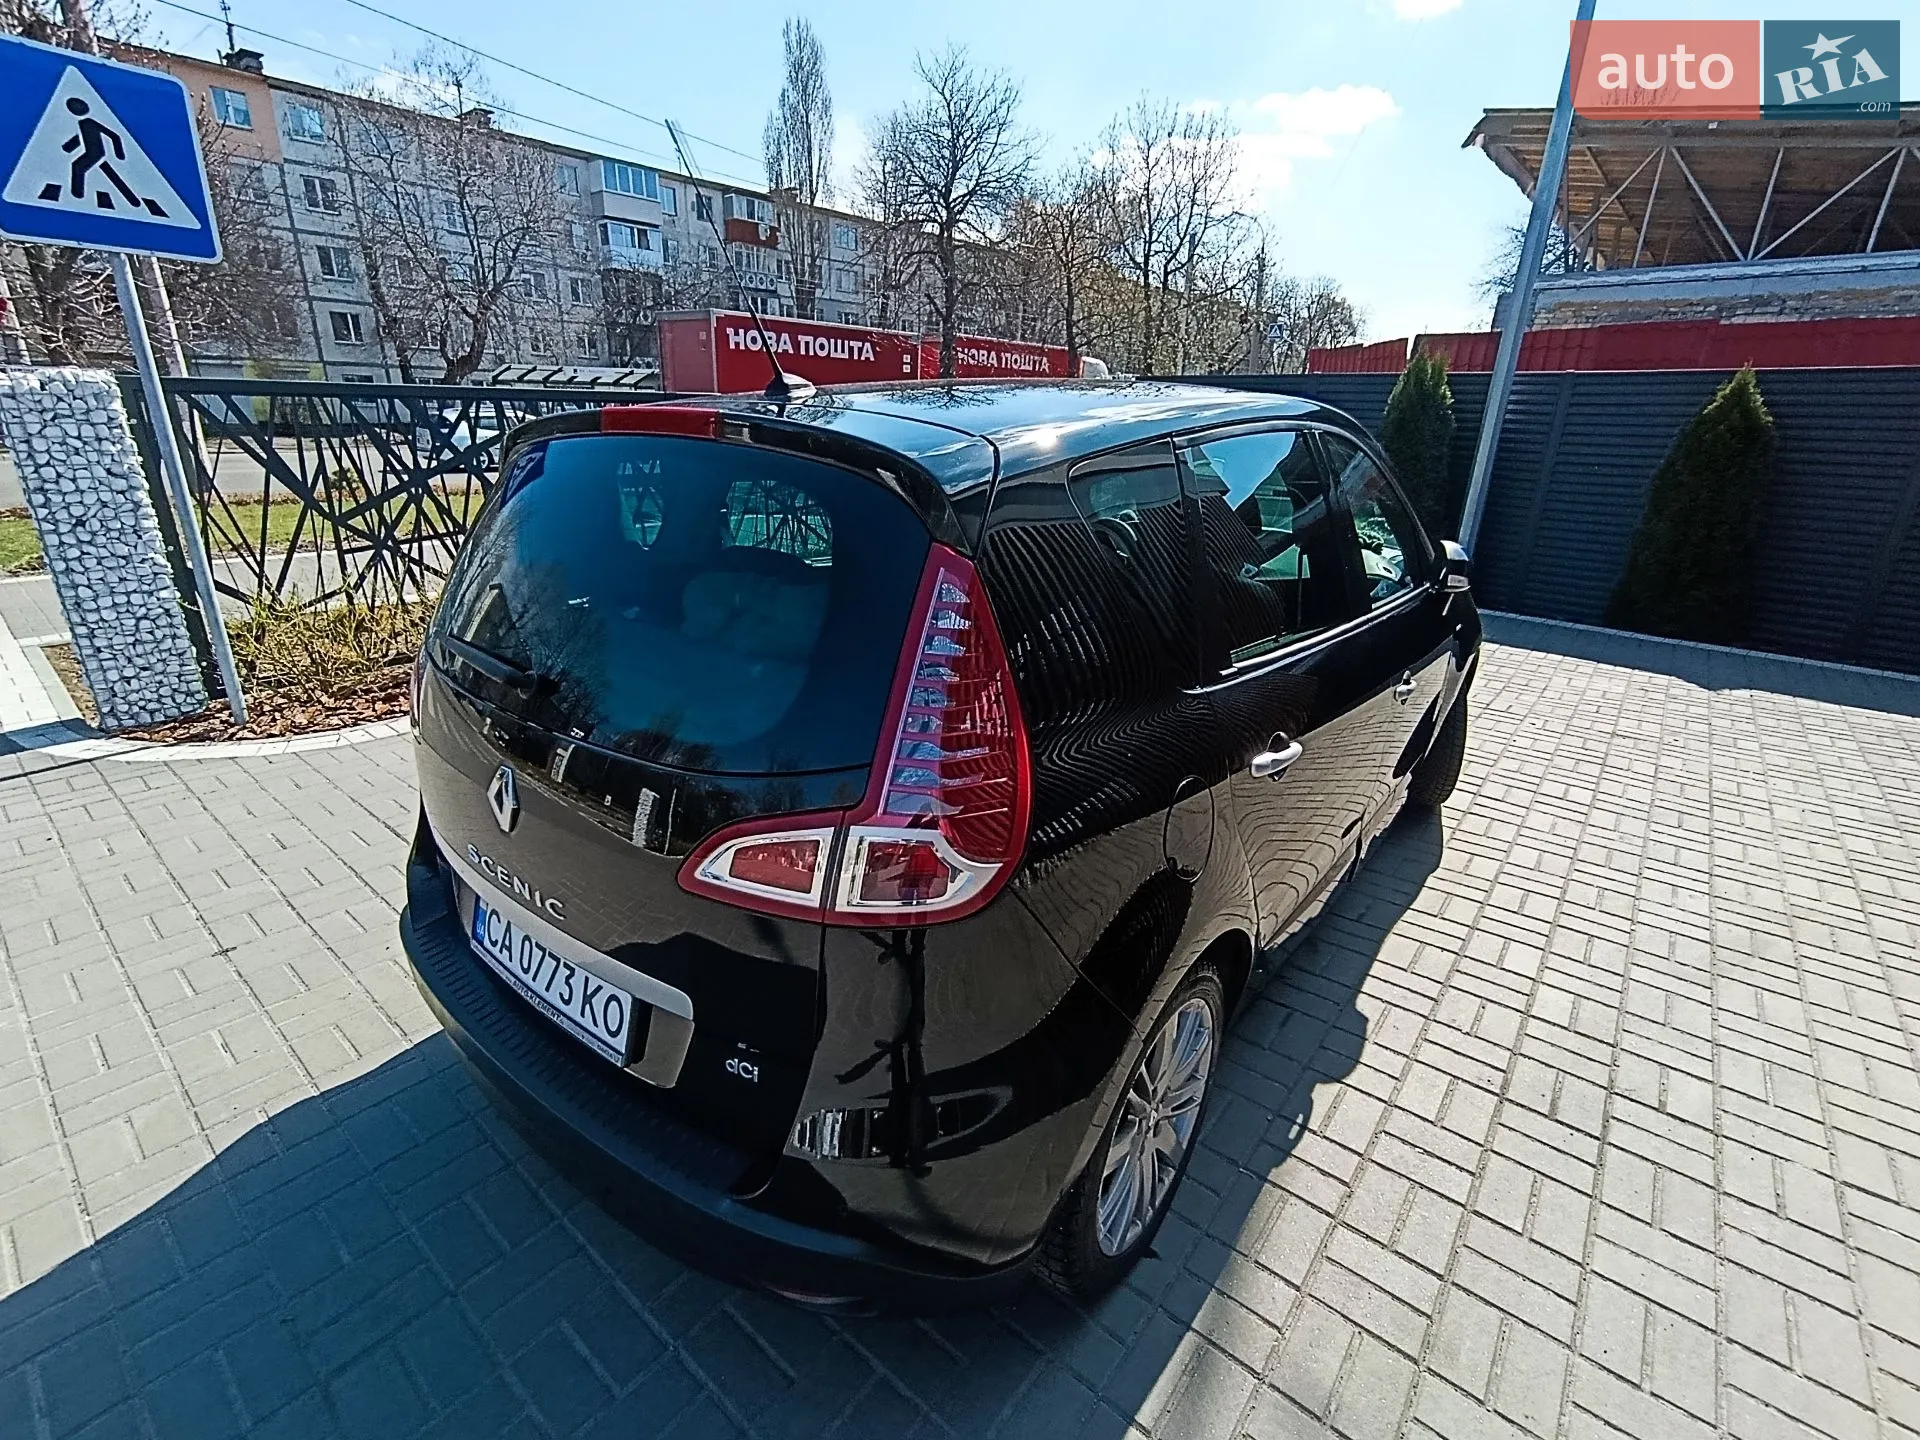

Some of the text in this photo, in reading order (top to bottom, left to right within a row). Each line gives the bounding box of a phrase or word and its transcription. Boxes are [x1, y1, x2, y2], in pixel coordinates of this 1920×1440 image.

[726, 327, 875, 361] НОВА ПОШТА
[1000, 351, 1050, 374] ПОШТА
[487, 908, 513, 963] CA
[519, 934, 576, 1007] 0773
[579, 975, 625, 1038] KO
[725, 1058, 759, 1083] dCi
